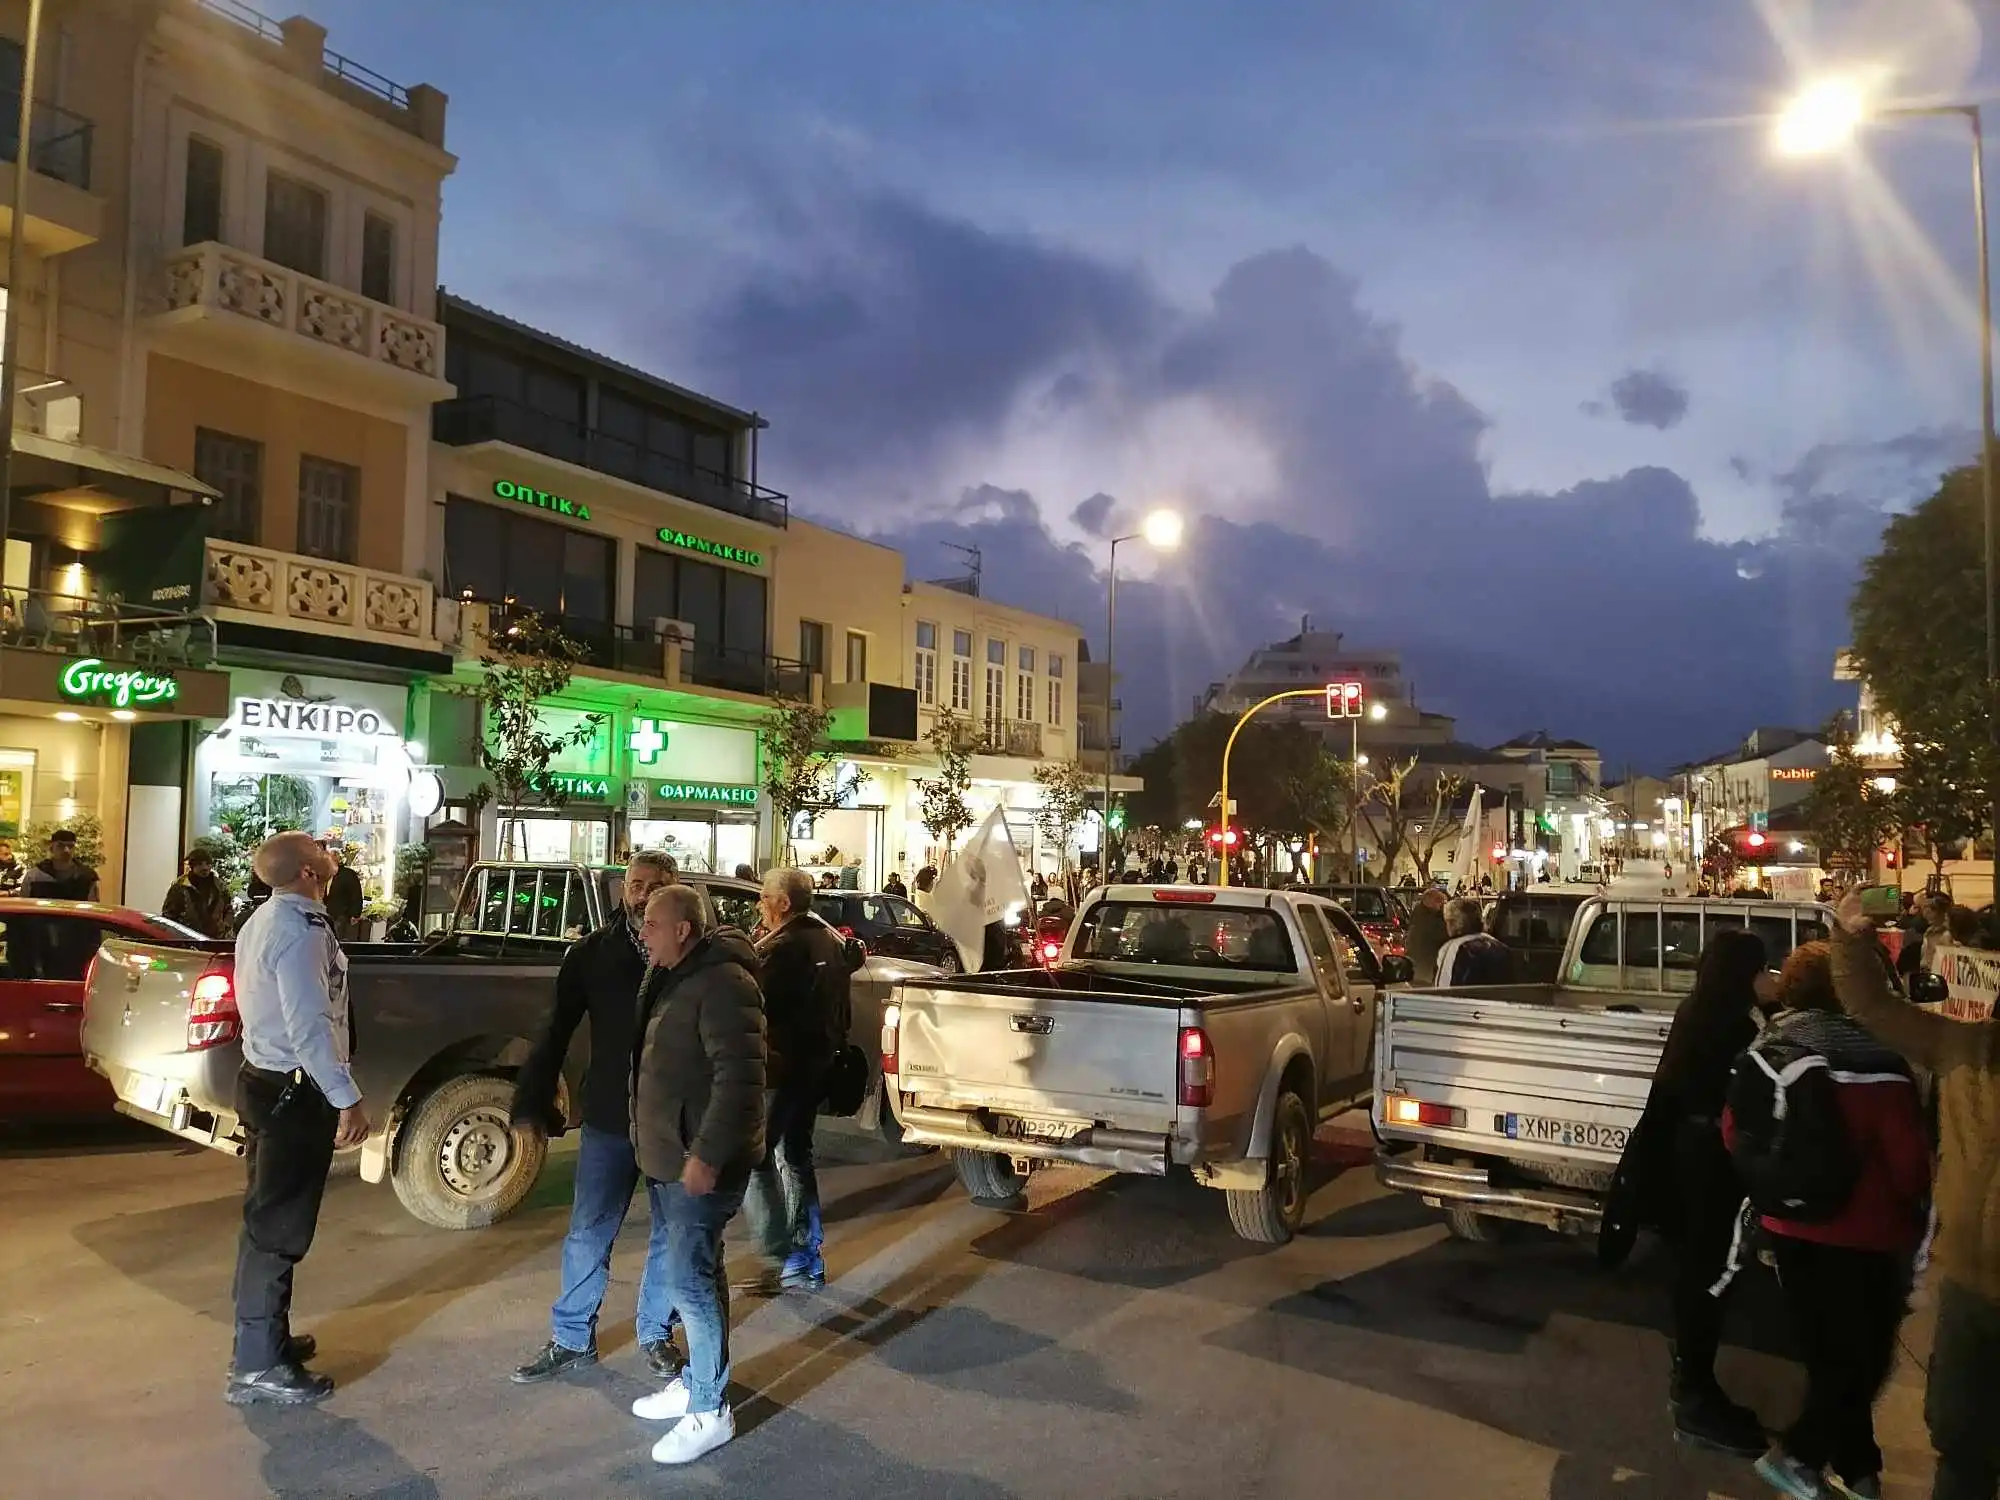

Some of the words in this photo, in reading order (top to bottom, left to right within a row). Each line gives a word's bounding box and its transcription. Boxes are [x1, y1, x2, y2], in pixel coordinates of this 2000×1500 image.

[495, 479, 591, 520] ΟΠΤΙΚΑ
[657, 527, 763, 567] ΦΑΡΜΑΚΕΙΟ
[660, 783, 758, 802] ΦΑΡΜΑΚΕΙΟ
